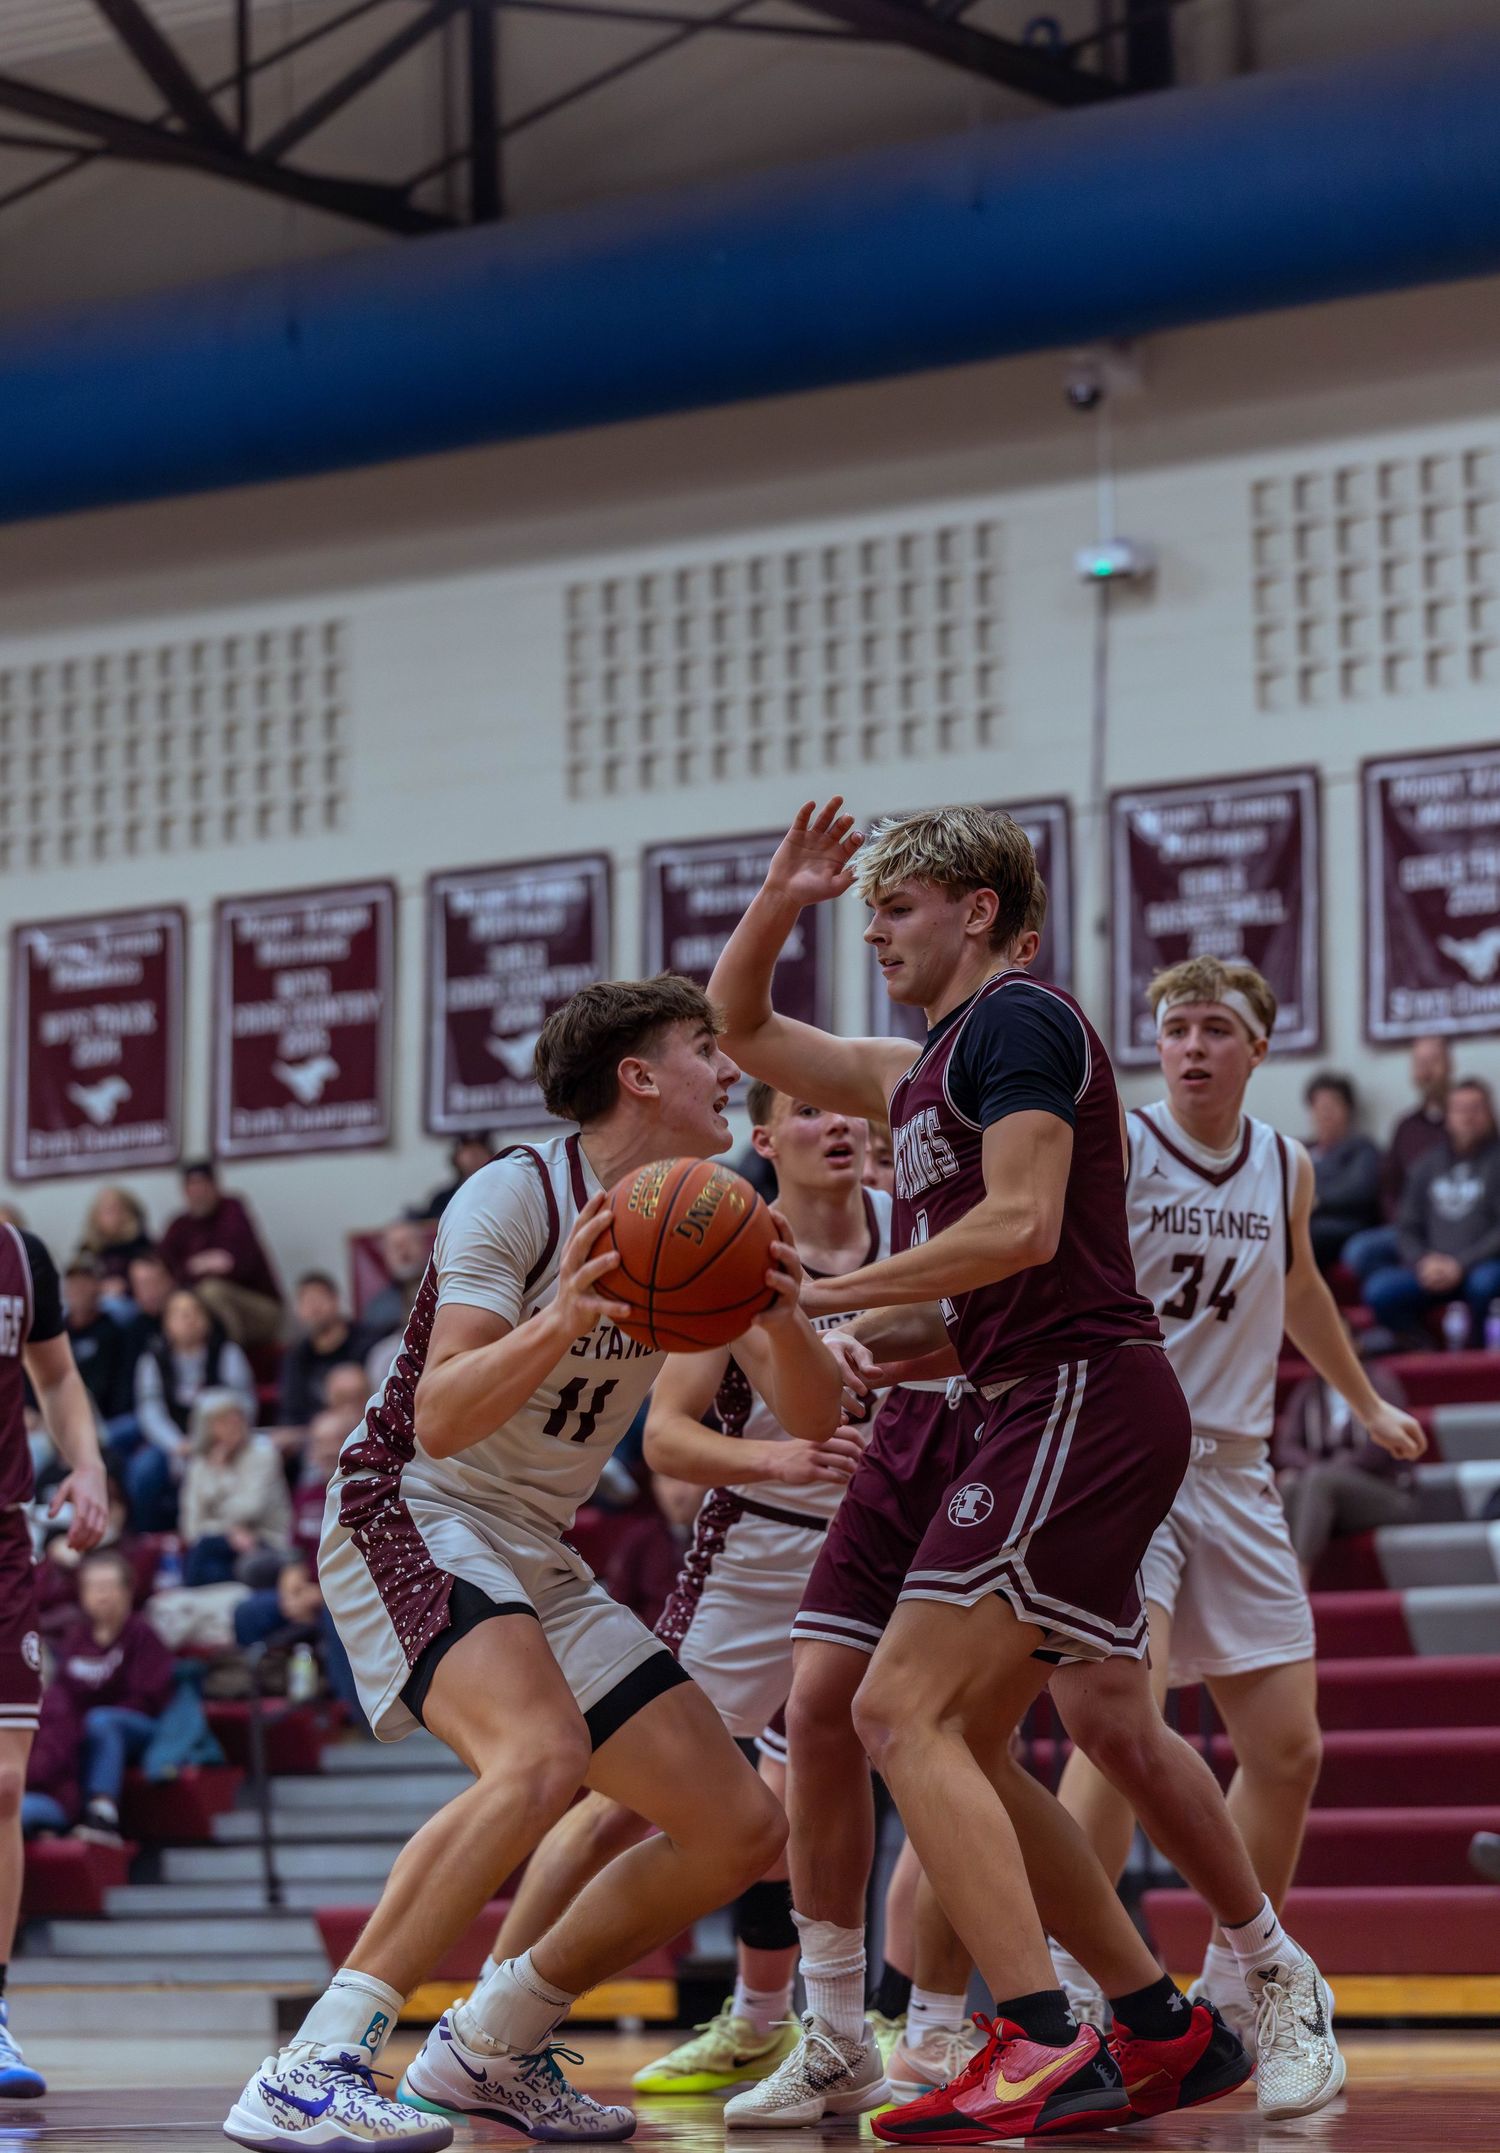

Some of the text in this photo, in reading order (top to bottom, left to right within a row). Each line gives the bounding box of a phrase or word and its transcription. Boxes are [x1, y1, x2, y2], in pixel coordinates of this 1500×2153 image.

[1150, 1205, 1270, 1241] MUSTANGS
[1161, 1252, 1238, 1322] 34
[542, 1376, 620, 1443] 11
